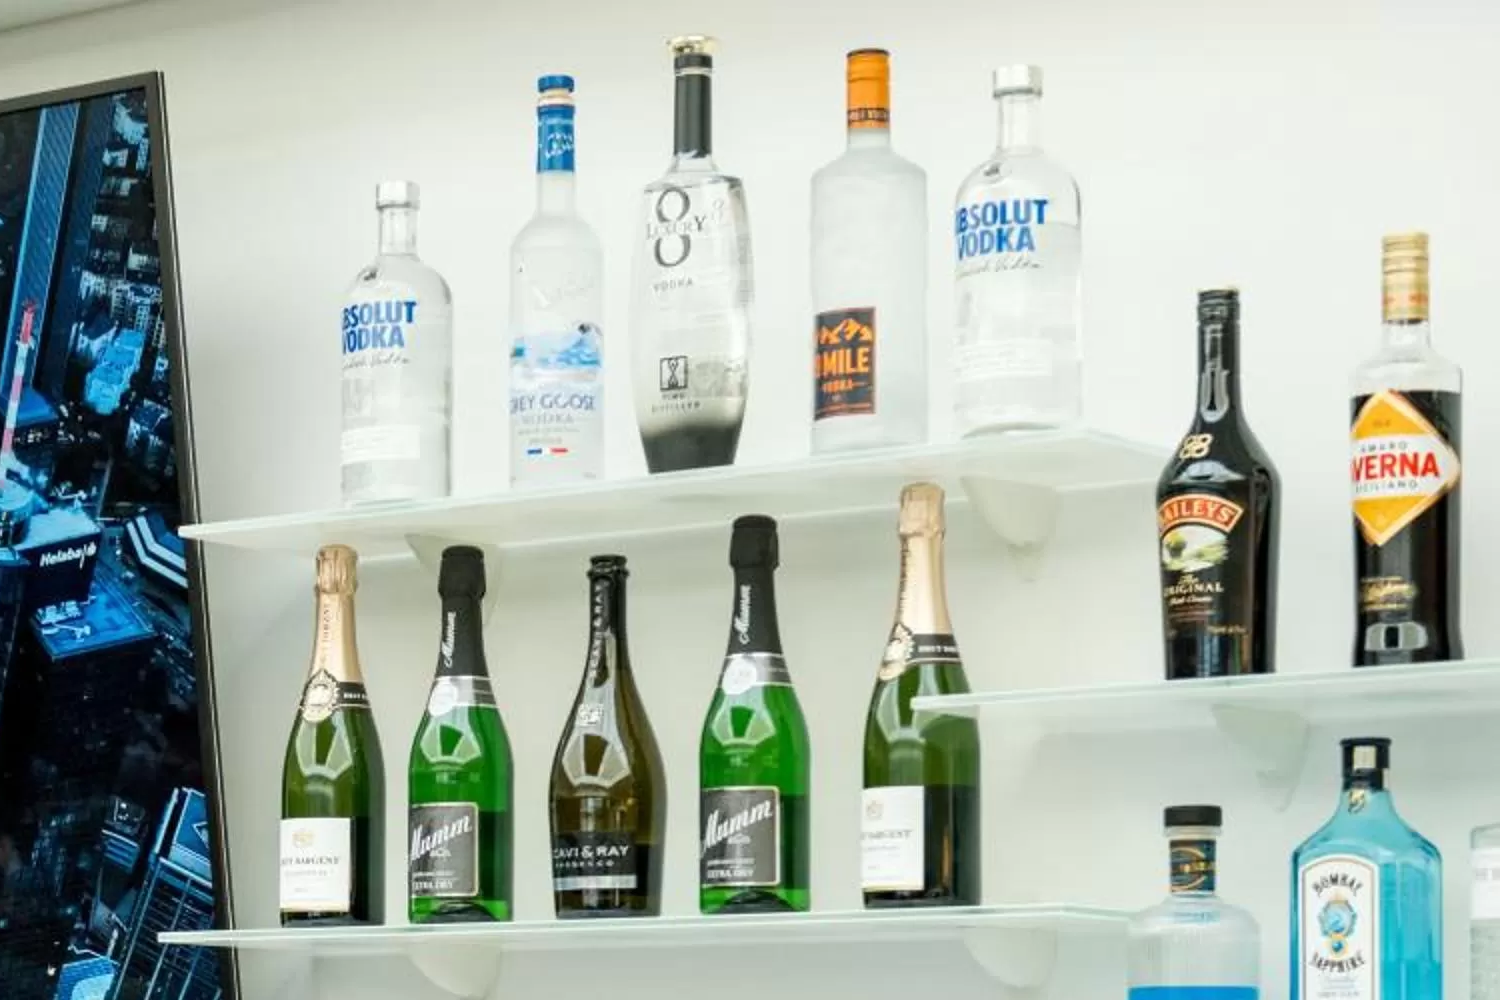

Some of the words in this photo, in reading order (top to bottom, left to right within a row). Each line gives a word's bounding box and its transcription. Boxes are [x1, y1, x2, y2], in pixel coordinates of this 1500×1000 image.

[955, 200, 1047, 236] BSOLUT
[342, 301, 417, 331] BSOLUT
[1352, 452, 1441, 483] VERNA
[1160, 499, 1235, 527] AILEYS
[552, 846, 579, 860] CAVI
[596, 844, 629, 858] RAY
[1312, 873, 1363, 898] BOMBAY
[1311, 950, 1366, 973] SAPPHIRE
